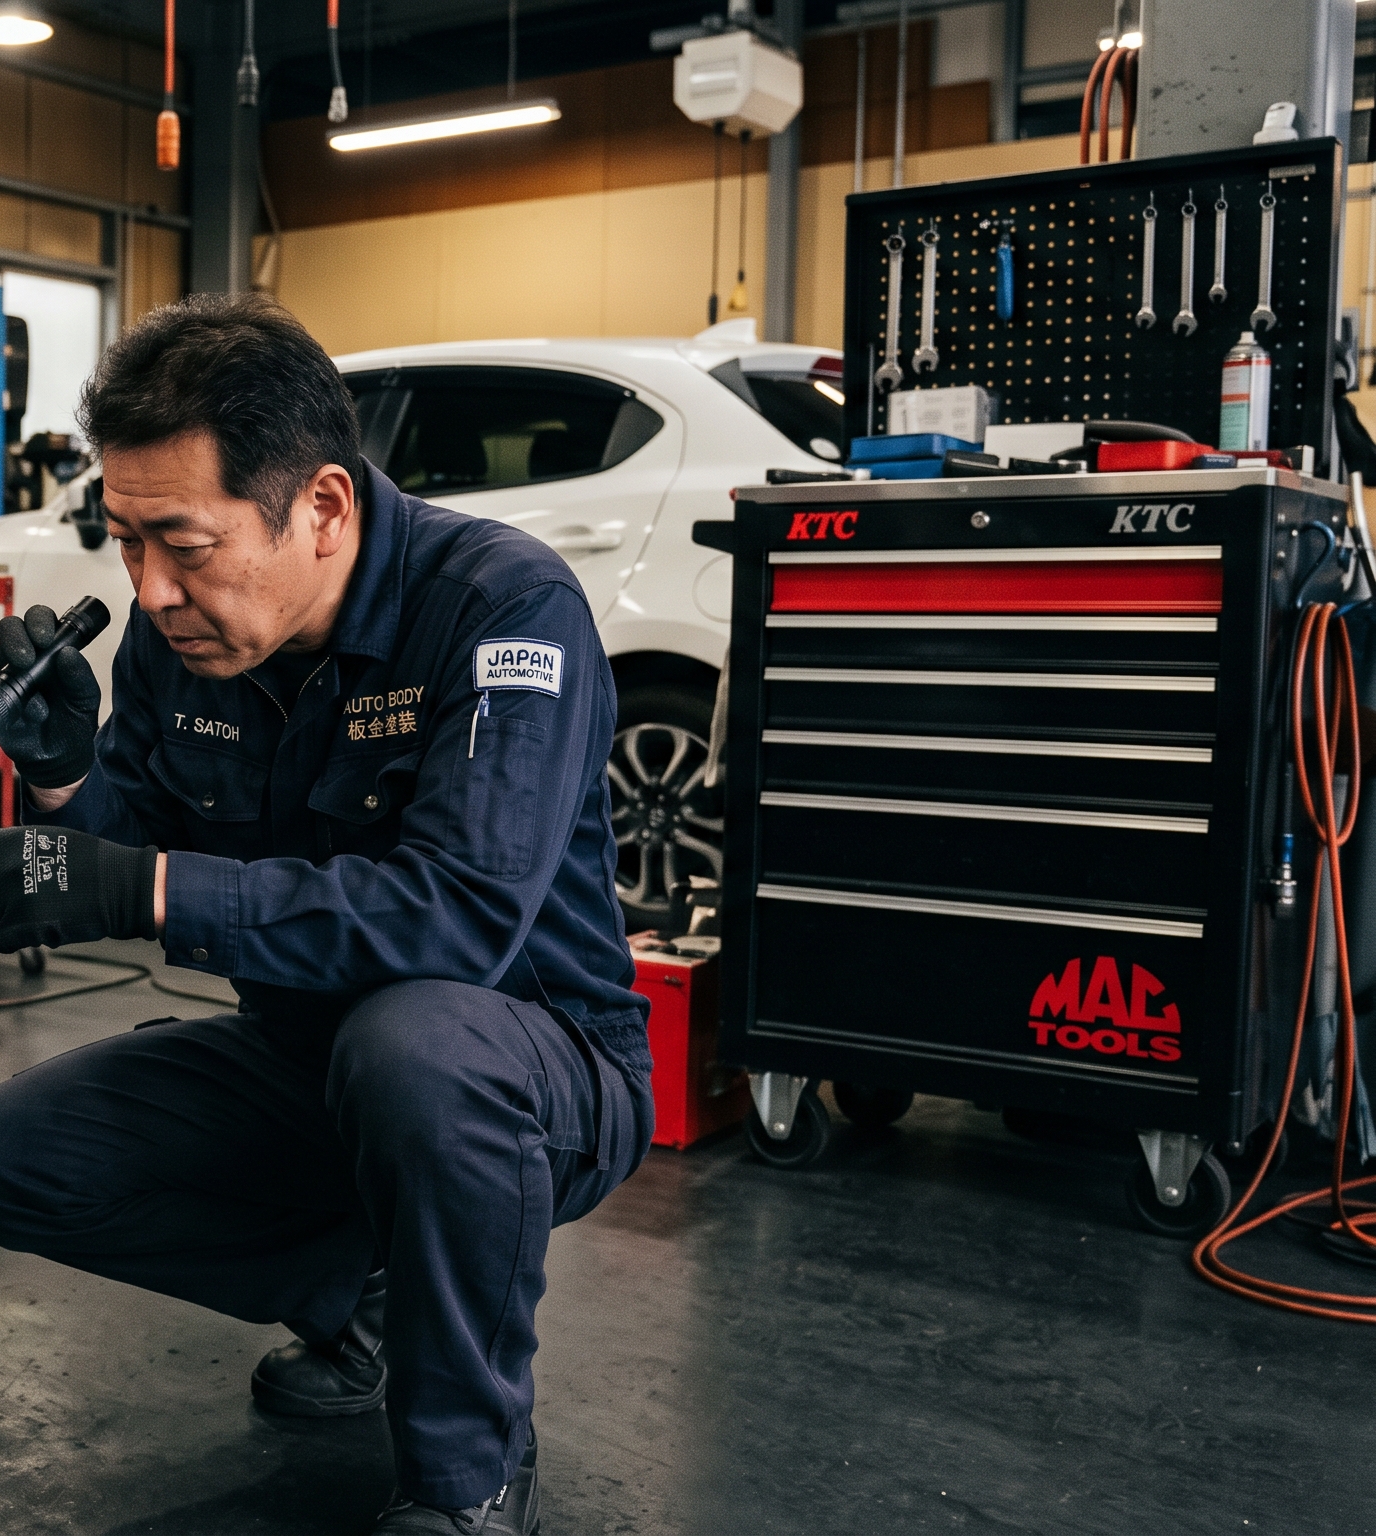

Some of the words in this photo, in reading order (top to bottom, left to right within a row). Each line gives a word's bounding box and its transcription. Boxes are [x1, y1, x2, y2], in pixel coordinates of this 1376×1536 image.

[787, 511, 859, 540] KTC
[1109, 504, 1195, 533] KTC
[487, 649, 553, 671] JAPAN
[486, 668, 553, 683] AUTOMOTIVE
[343, 695, 384, 715] AUTO
[388, 685, 424, 707] BODY
[174, 713, 187, 730] T.
[193, 717, 240, 741] SATOH
[347, 710, 417, 741] 板金塗装
[1029, 955, 1181, 1034] MAC
[1028, 1020, 1182, 1063] TOOLS
